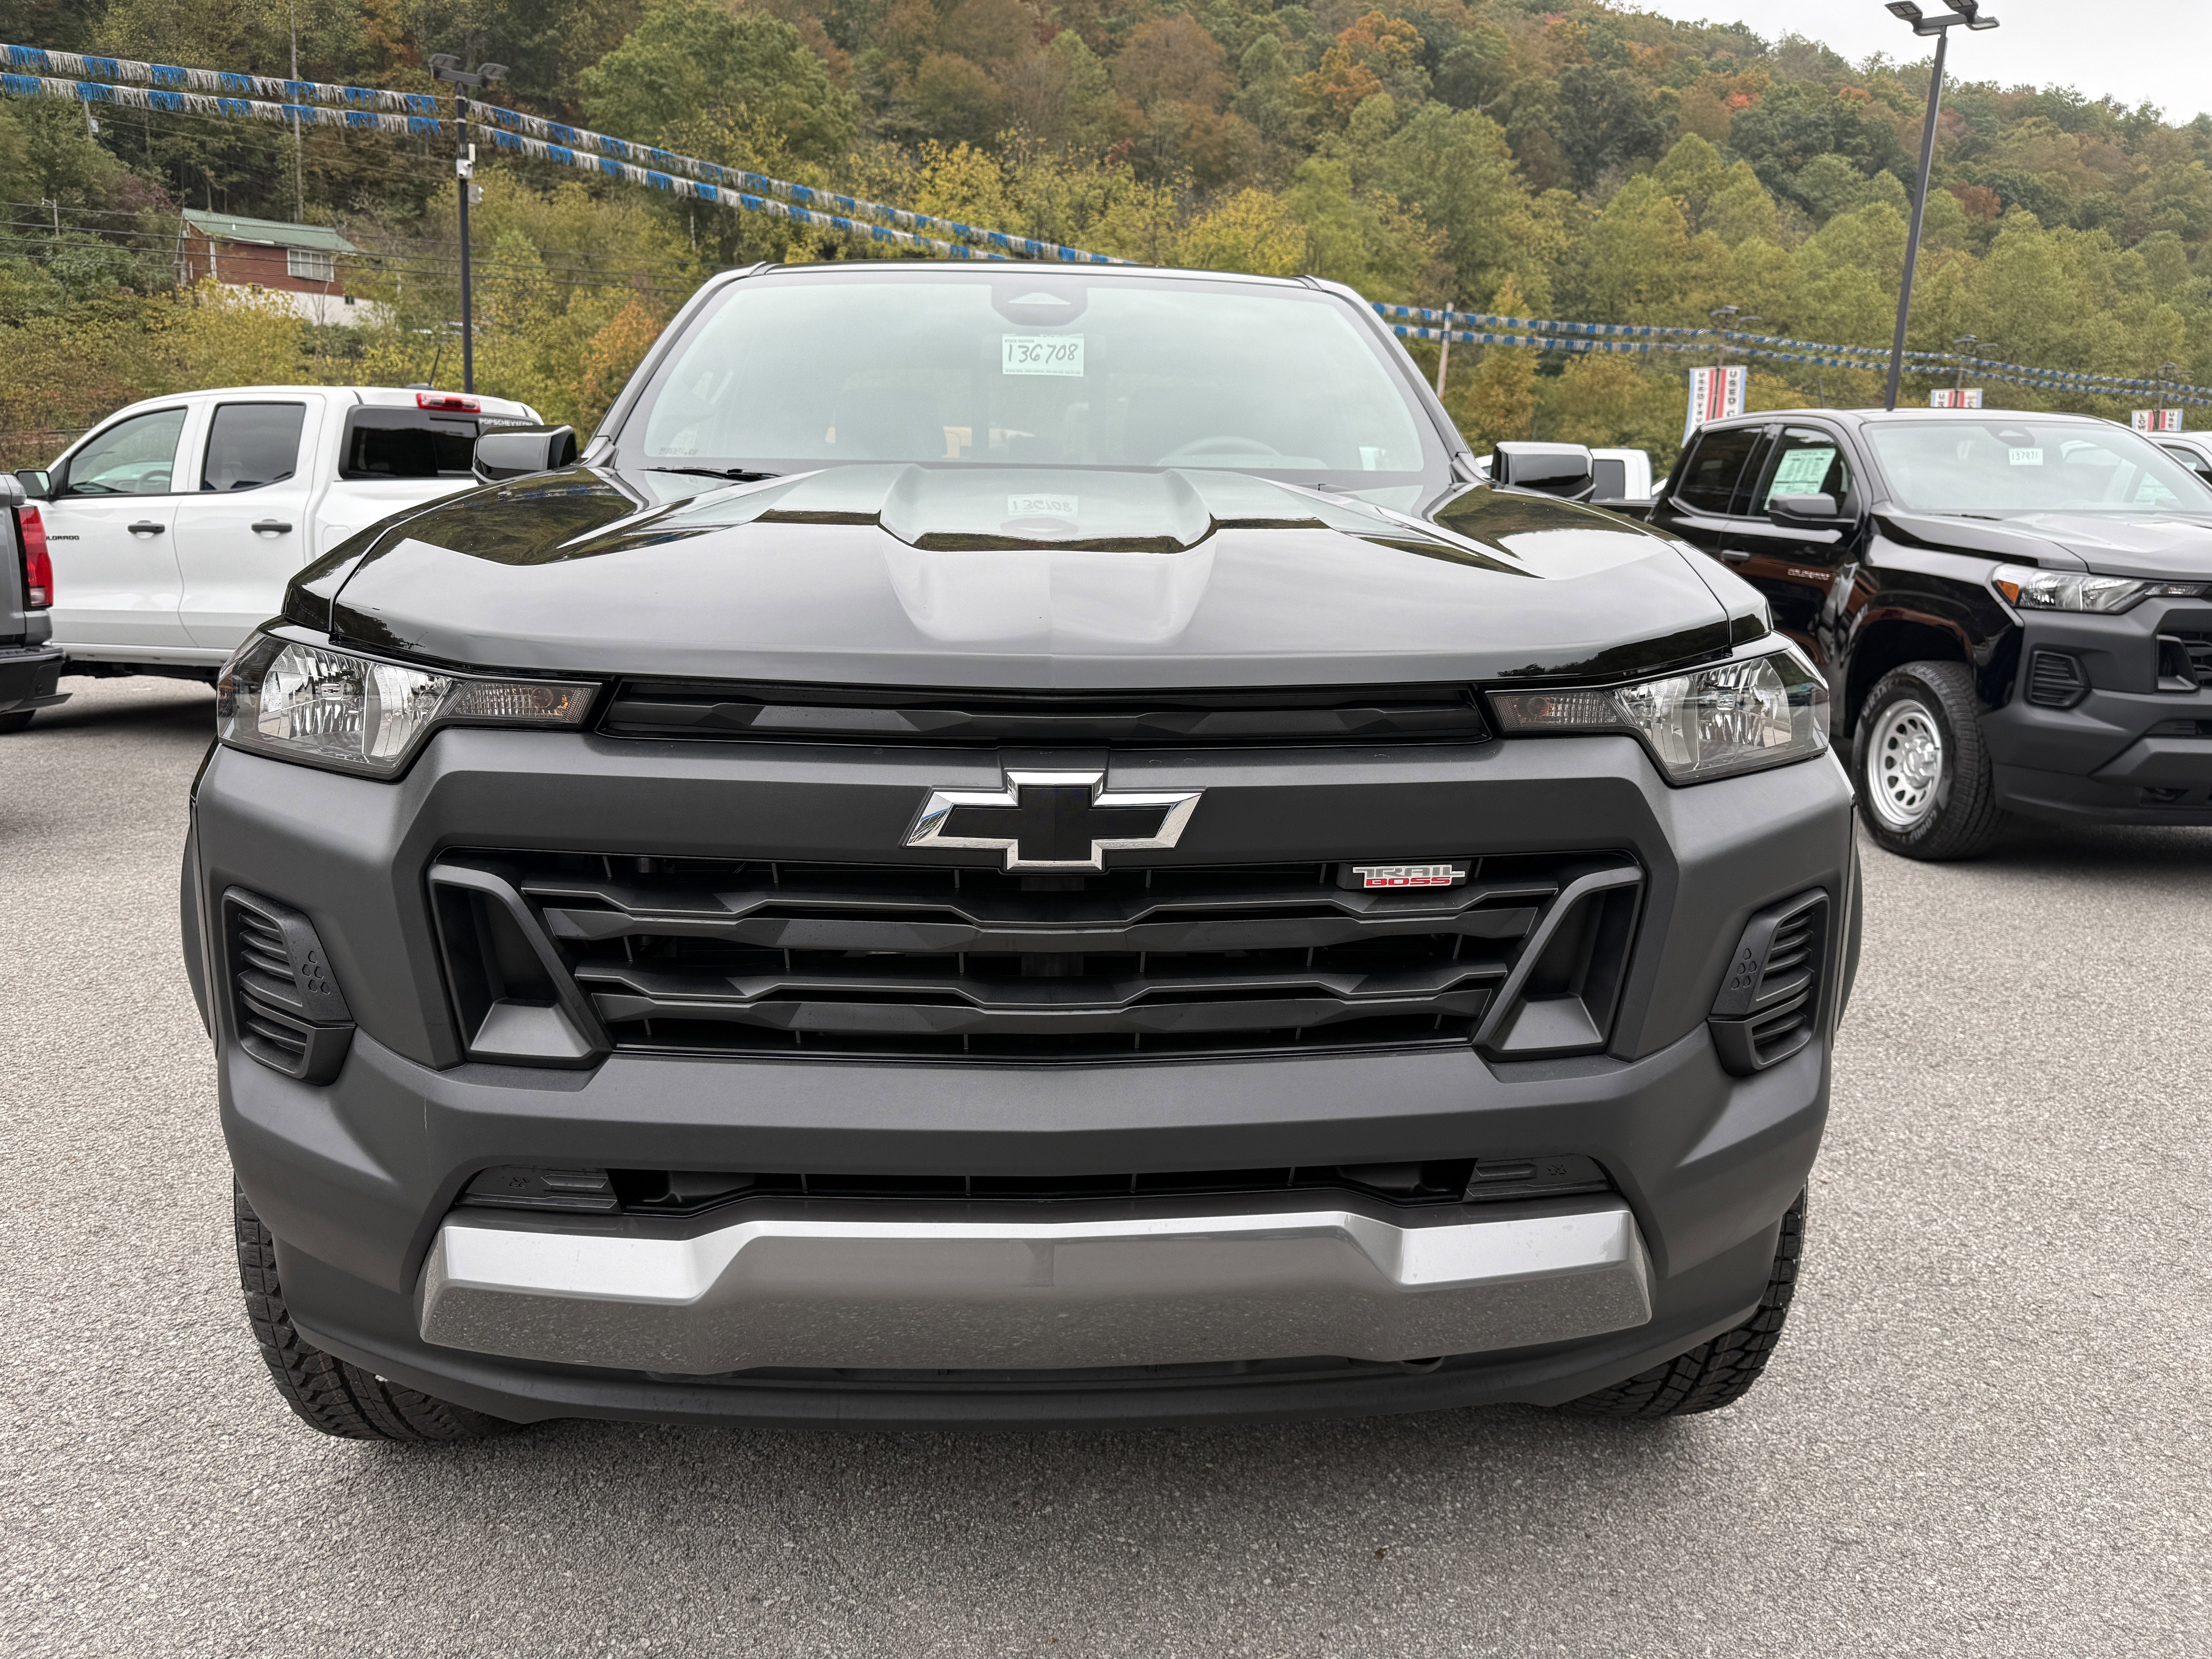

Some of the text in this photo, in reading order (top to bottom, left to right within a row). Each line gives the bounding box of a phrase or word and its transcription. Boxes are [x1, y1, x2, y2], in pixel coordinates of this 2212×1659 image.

[1008, 343, 1079, 364] 136708
[1728, 371, 1737, 405] USED
[1353, 864, 1465, 878] TRAIL
[1366, 876, 1451, 887] BOSS
